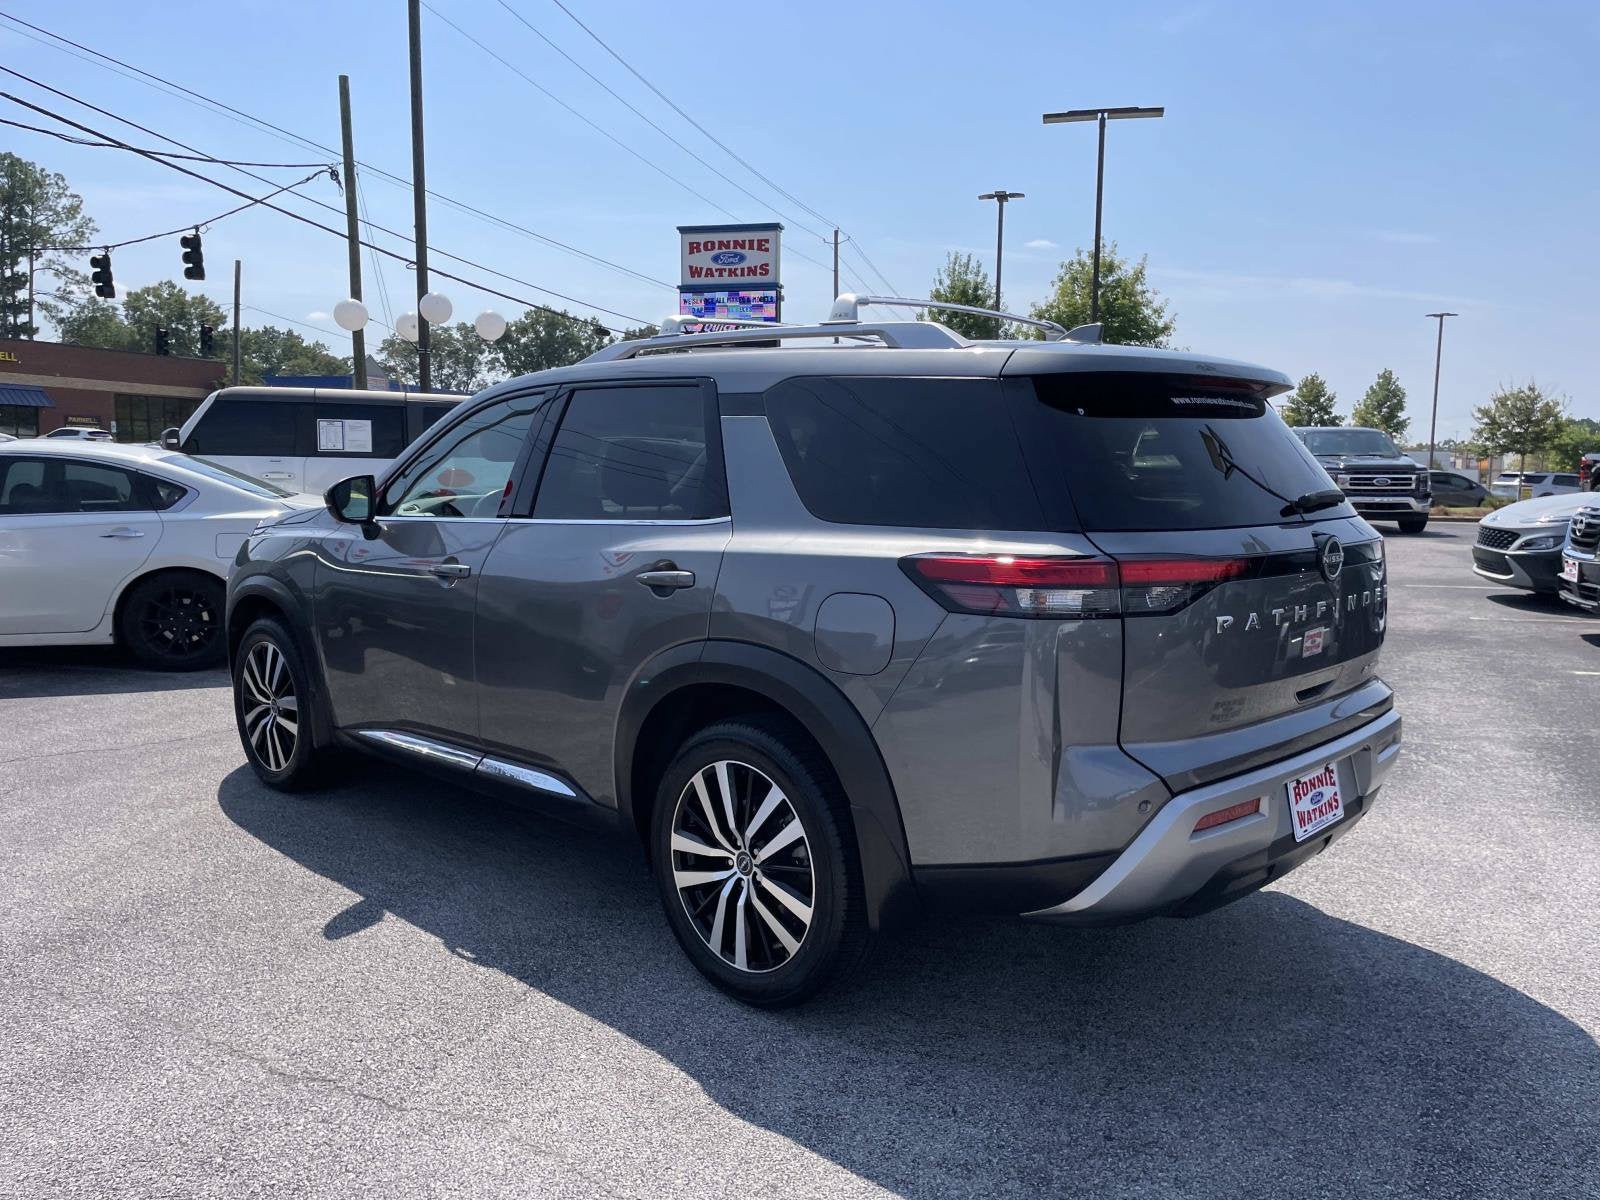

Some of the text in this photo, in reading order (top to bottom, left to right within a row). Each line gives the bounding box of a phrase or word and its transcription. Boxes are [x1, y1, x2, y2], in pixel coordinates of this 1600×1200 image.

[688, 238, 770, 255] RONNIE
[717, 253, 740, 264] Ford
[688, 262, 770, 279] WATKINS
[1292, 767, 1336, 806] RONNIE
[1296, 791, 1340, 829] WATKINS
